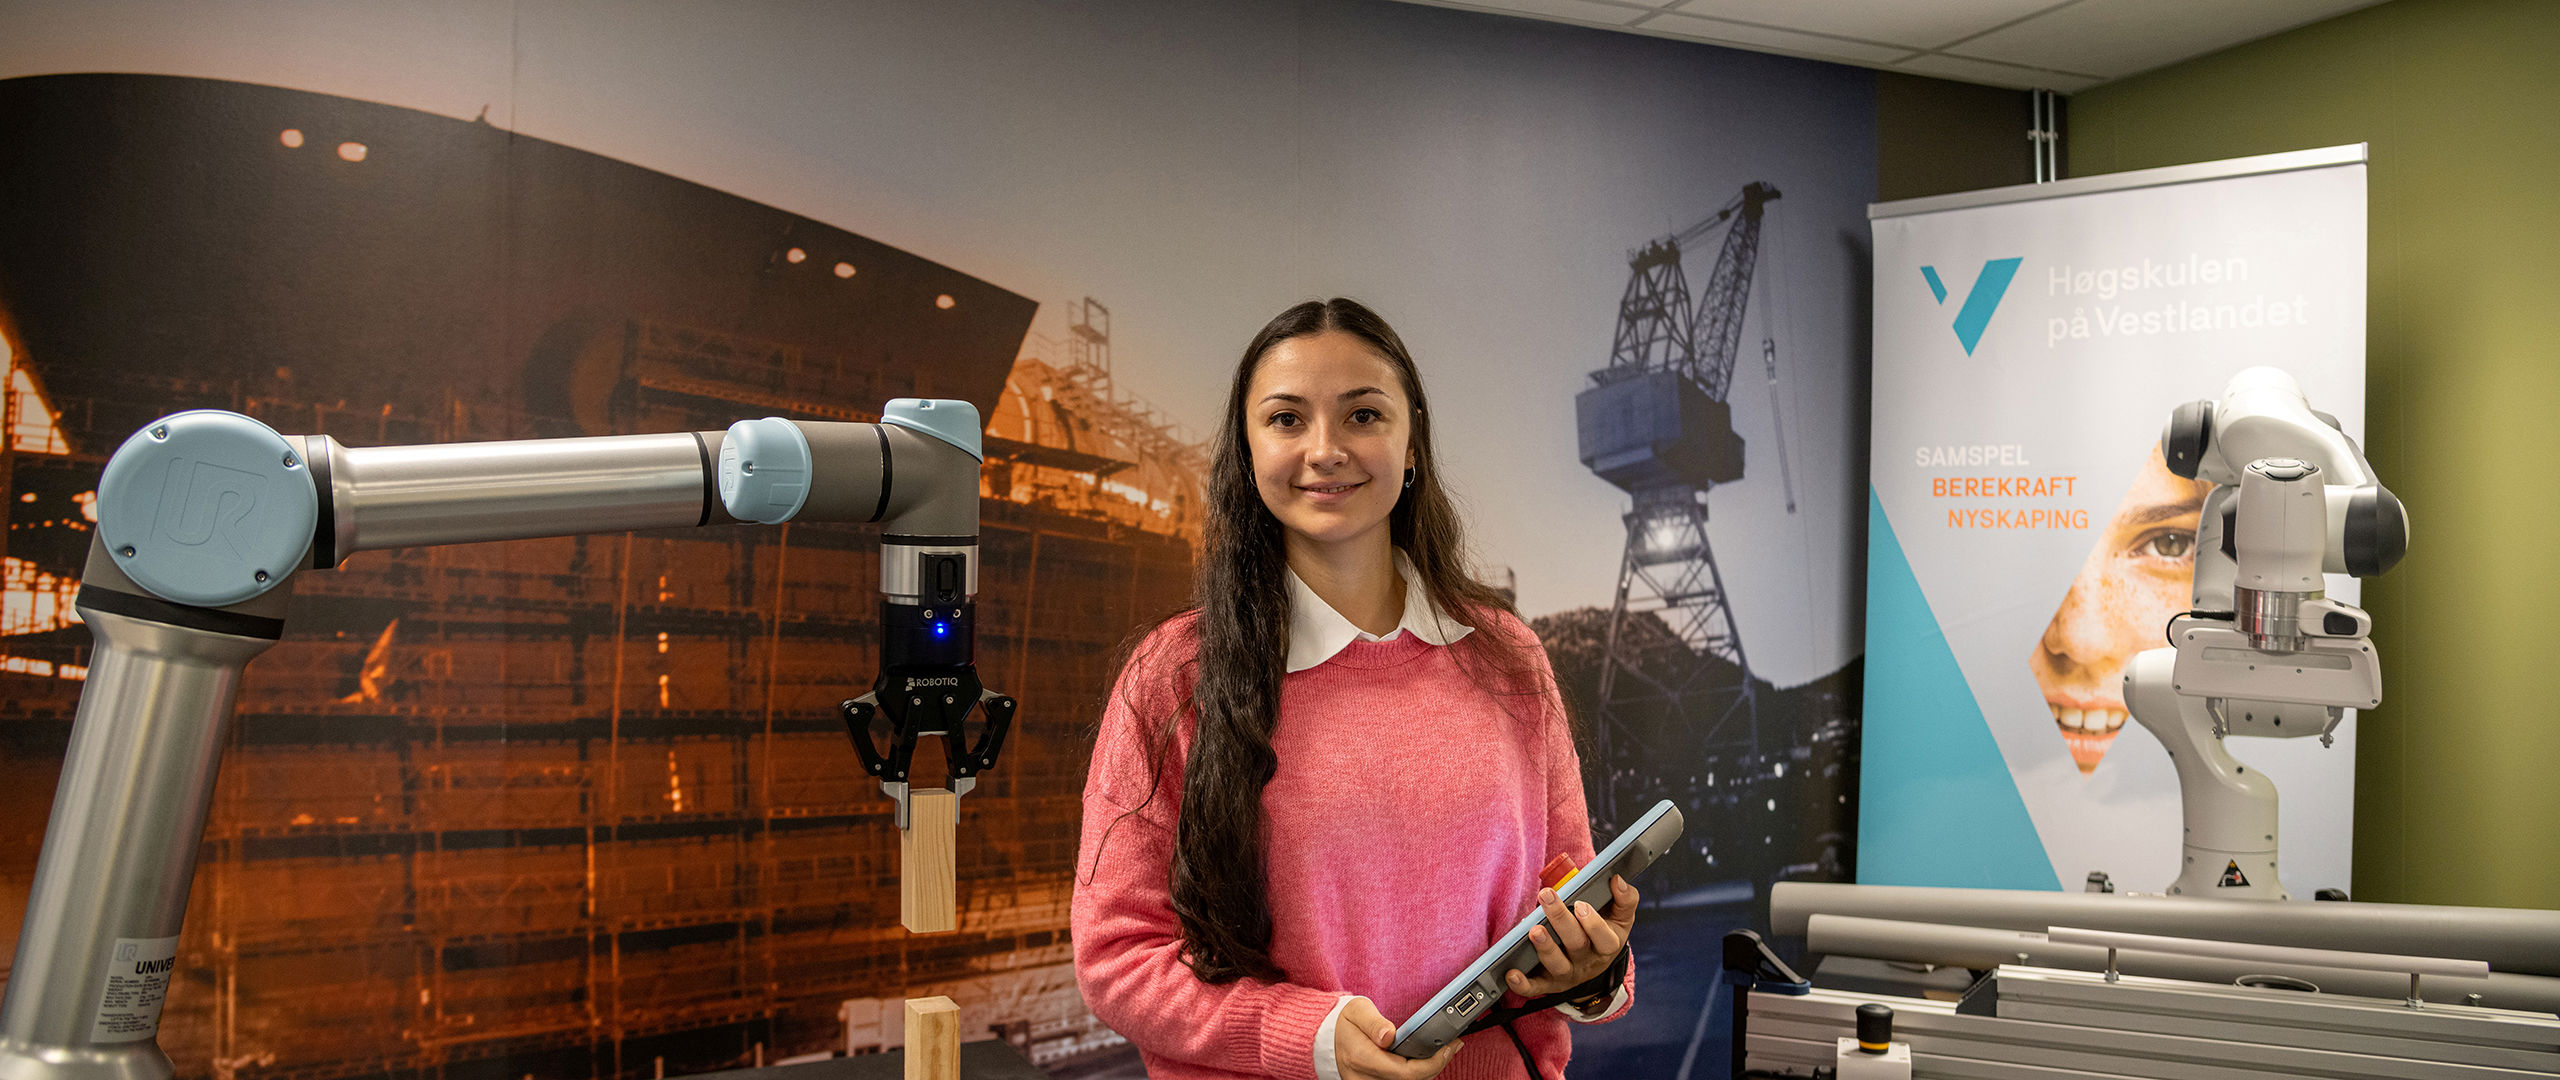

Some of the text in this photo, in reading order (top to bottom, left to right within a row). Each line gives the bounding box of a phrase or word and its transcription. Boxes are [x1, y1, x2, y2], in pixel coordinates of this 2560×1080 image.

[2049, 253, 2248, 300] Høgskulen
[2048, 294, 2309, 348] på Vestlandet
[1916, 444, 2029, 467] SAMSPEL
[1932, 476, 2077, 497] BEREKRAFT
[1948, 508, 2089, 529] NYSKAPING
[916, 677, 958, 687] ROBOTIQ
